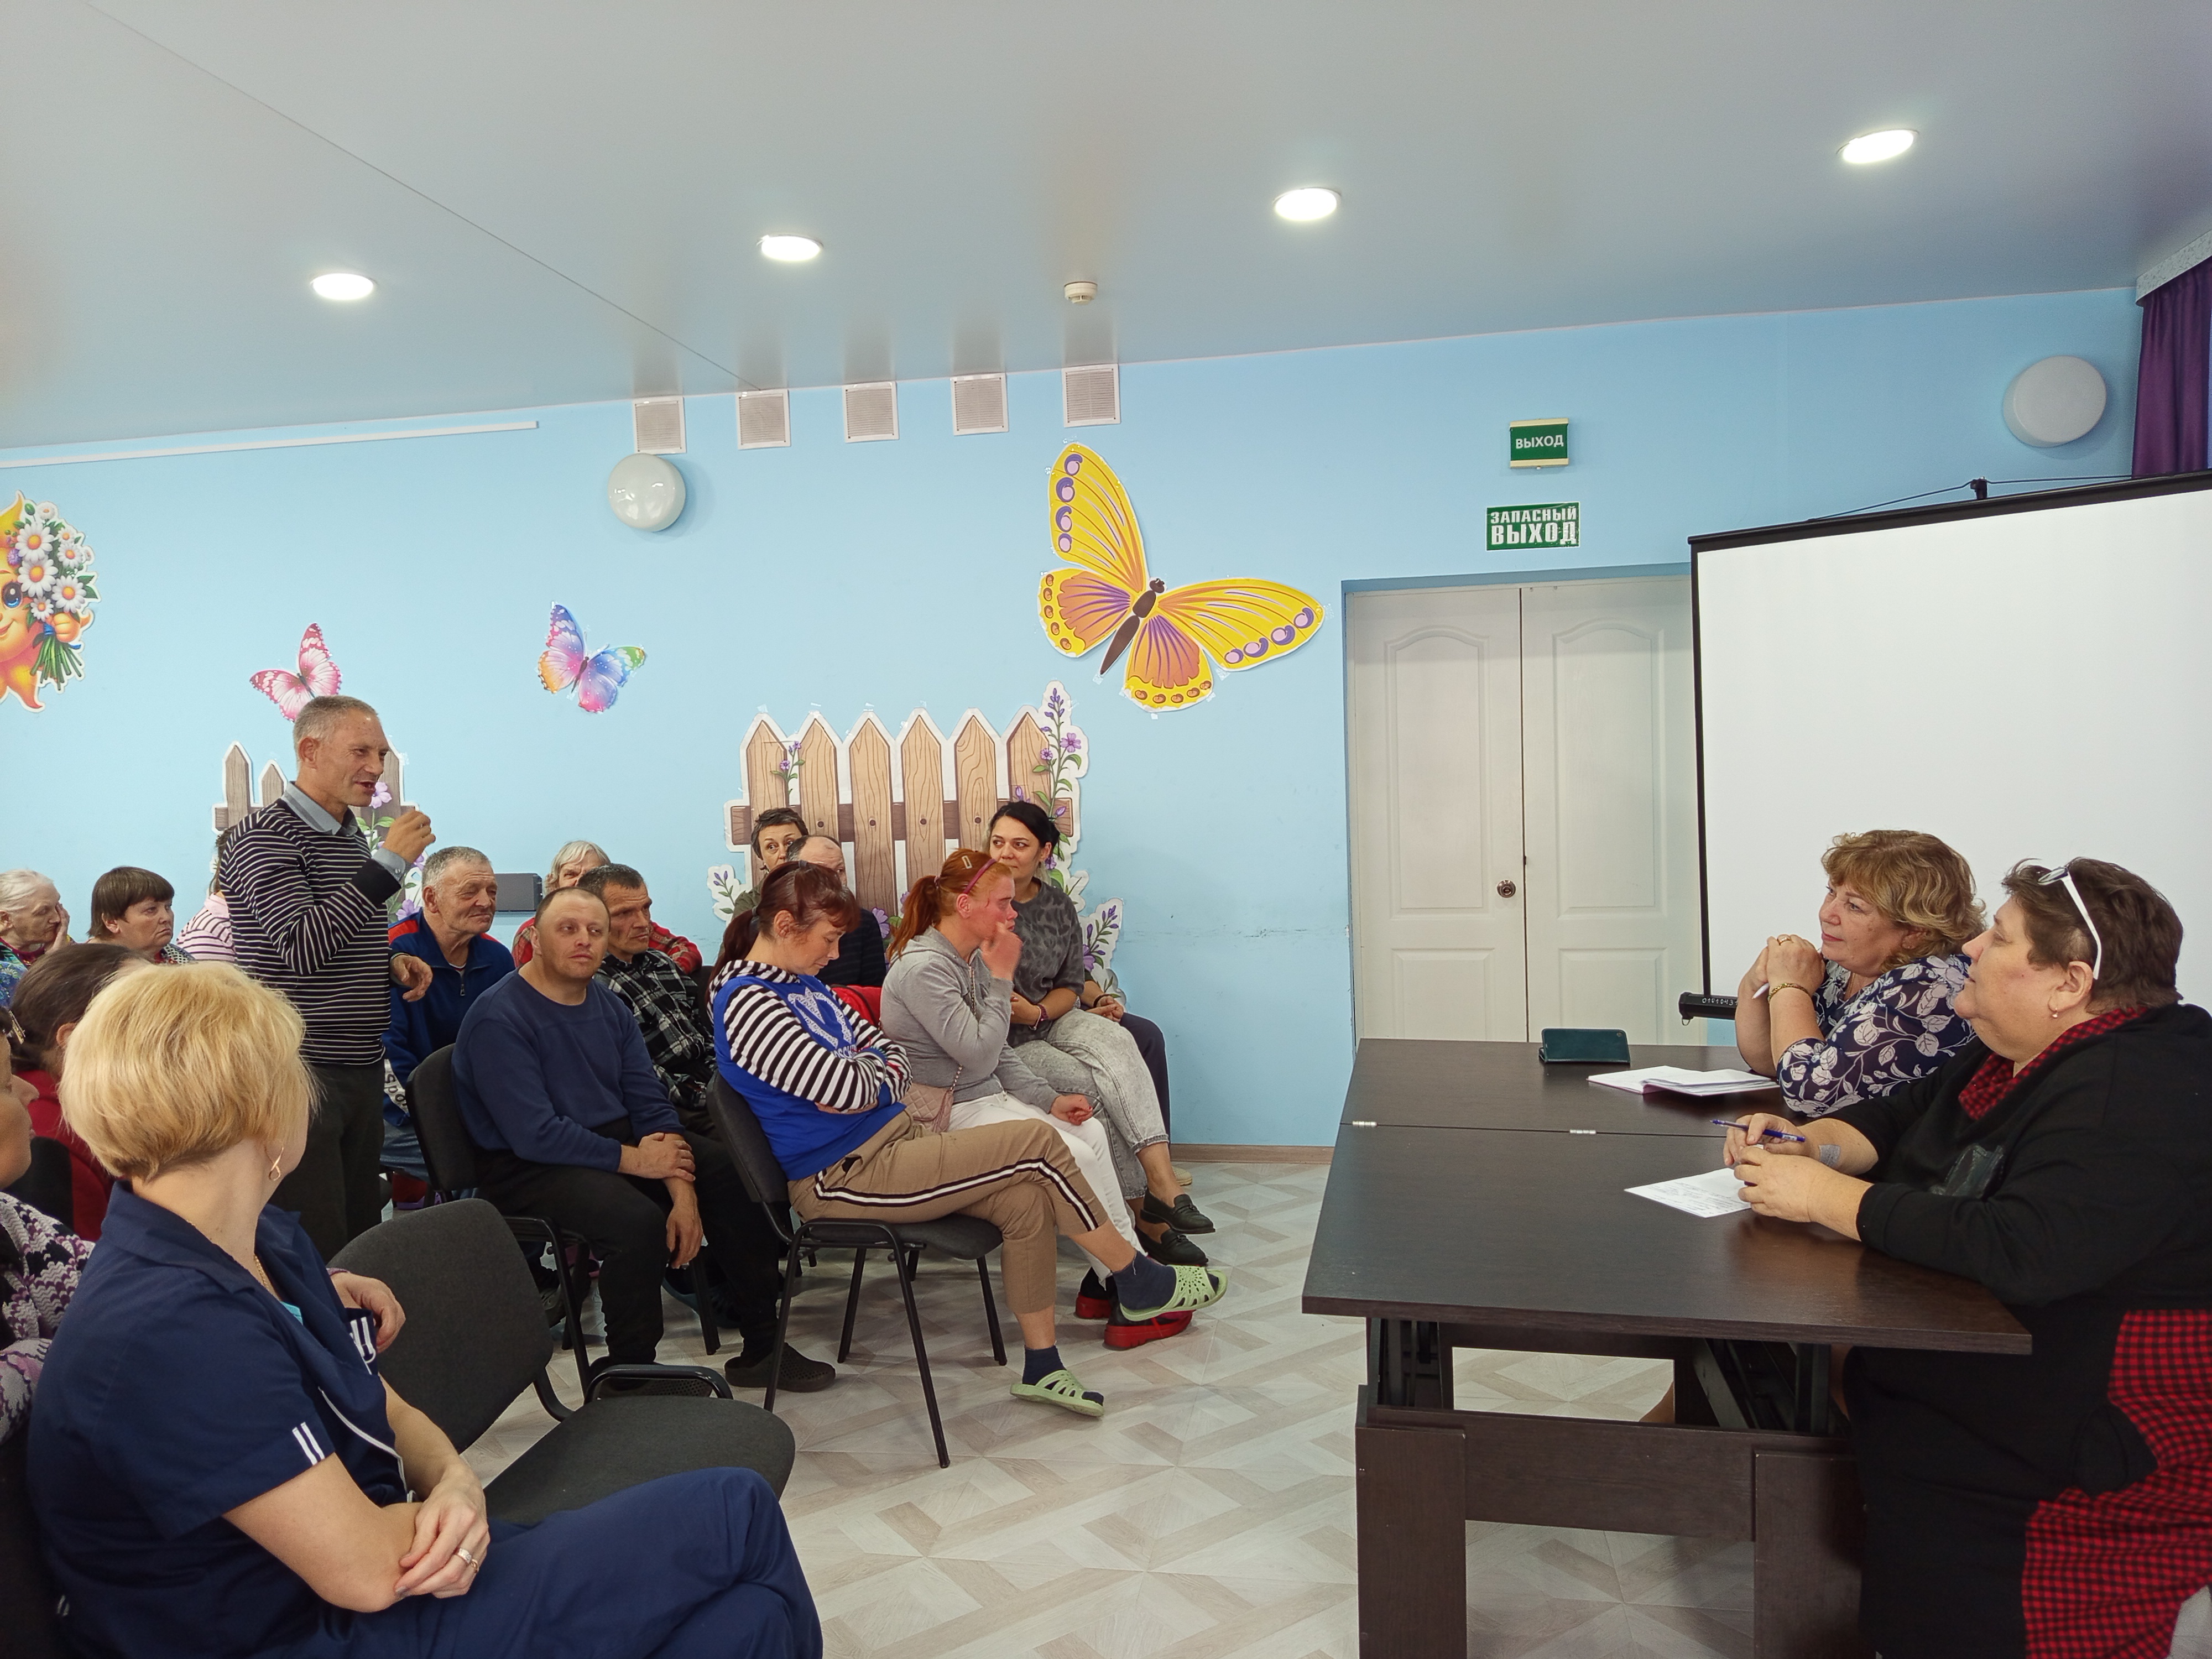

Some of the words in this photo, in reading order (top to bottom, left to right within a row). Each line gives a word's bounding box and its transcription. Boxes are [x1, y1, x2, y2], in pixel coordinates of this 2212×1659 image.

[1516, 435, 1564, 449] ВЫХОД
[1490, 506, 1576, 524] ЗАПАСНЫЙ
[1491, 521, 1577, 545] ВЫХОД
